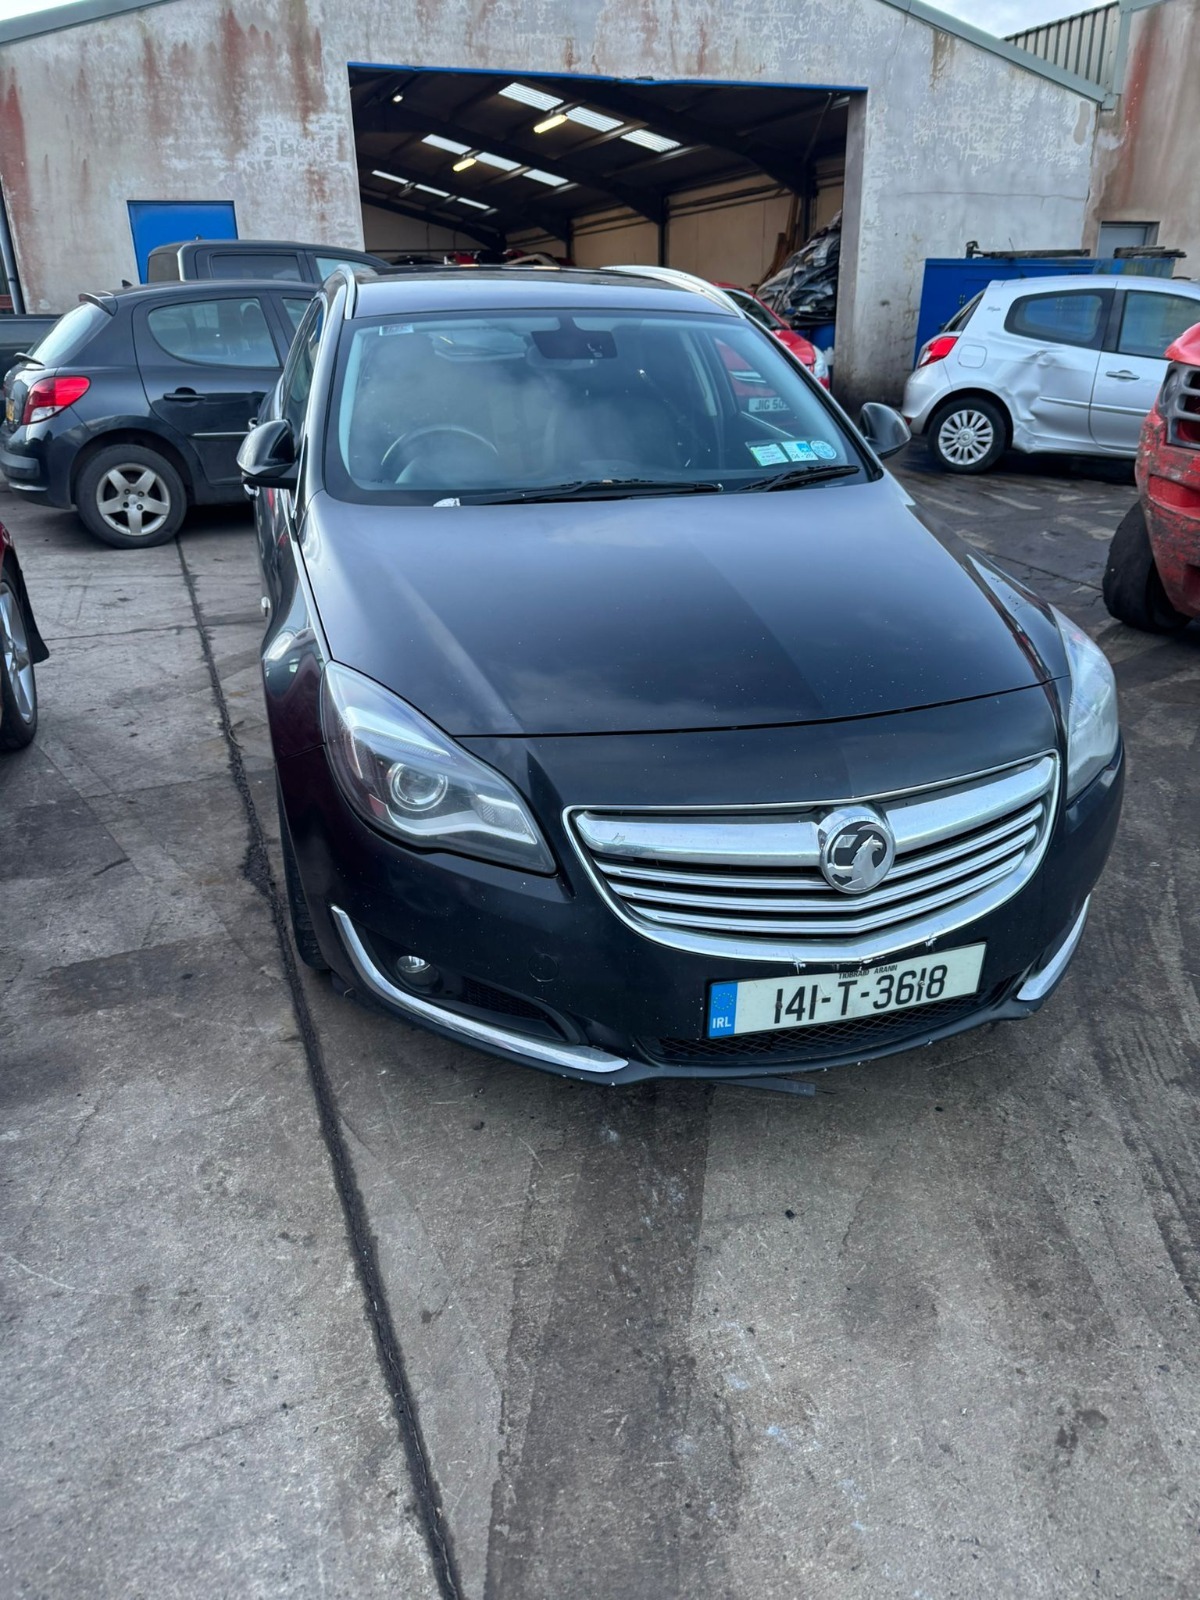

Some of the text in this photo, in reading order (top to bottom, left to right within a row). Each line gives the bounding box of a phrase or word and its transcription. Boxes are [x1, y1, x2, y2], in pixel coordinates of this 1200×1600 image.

[755, 399, 770, 410] JIG
[773, 964, 948, 1024] 141-T-3618
[712, 1016, 732, 1029] IRL
